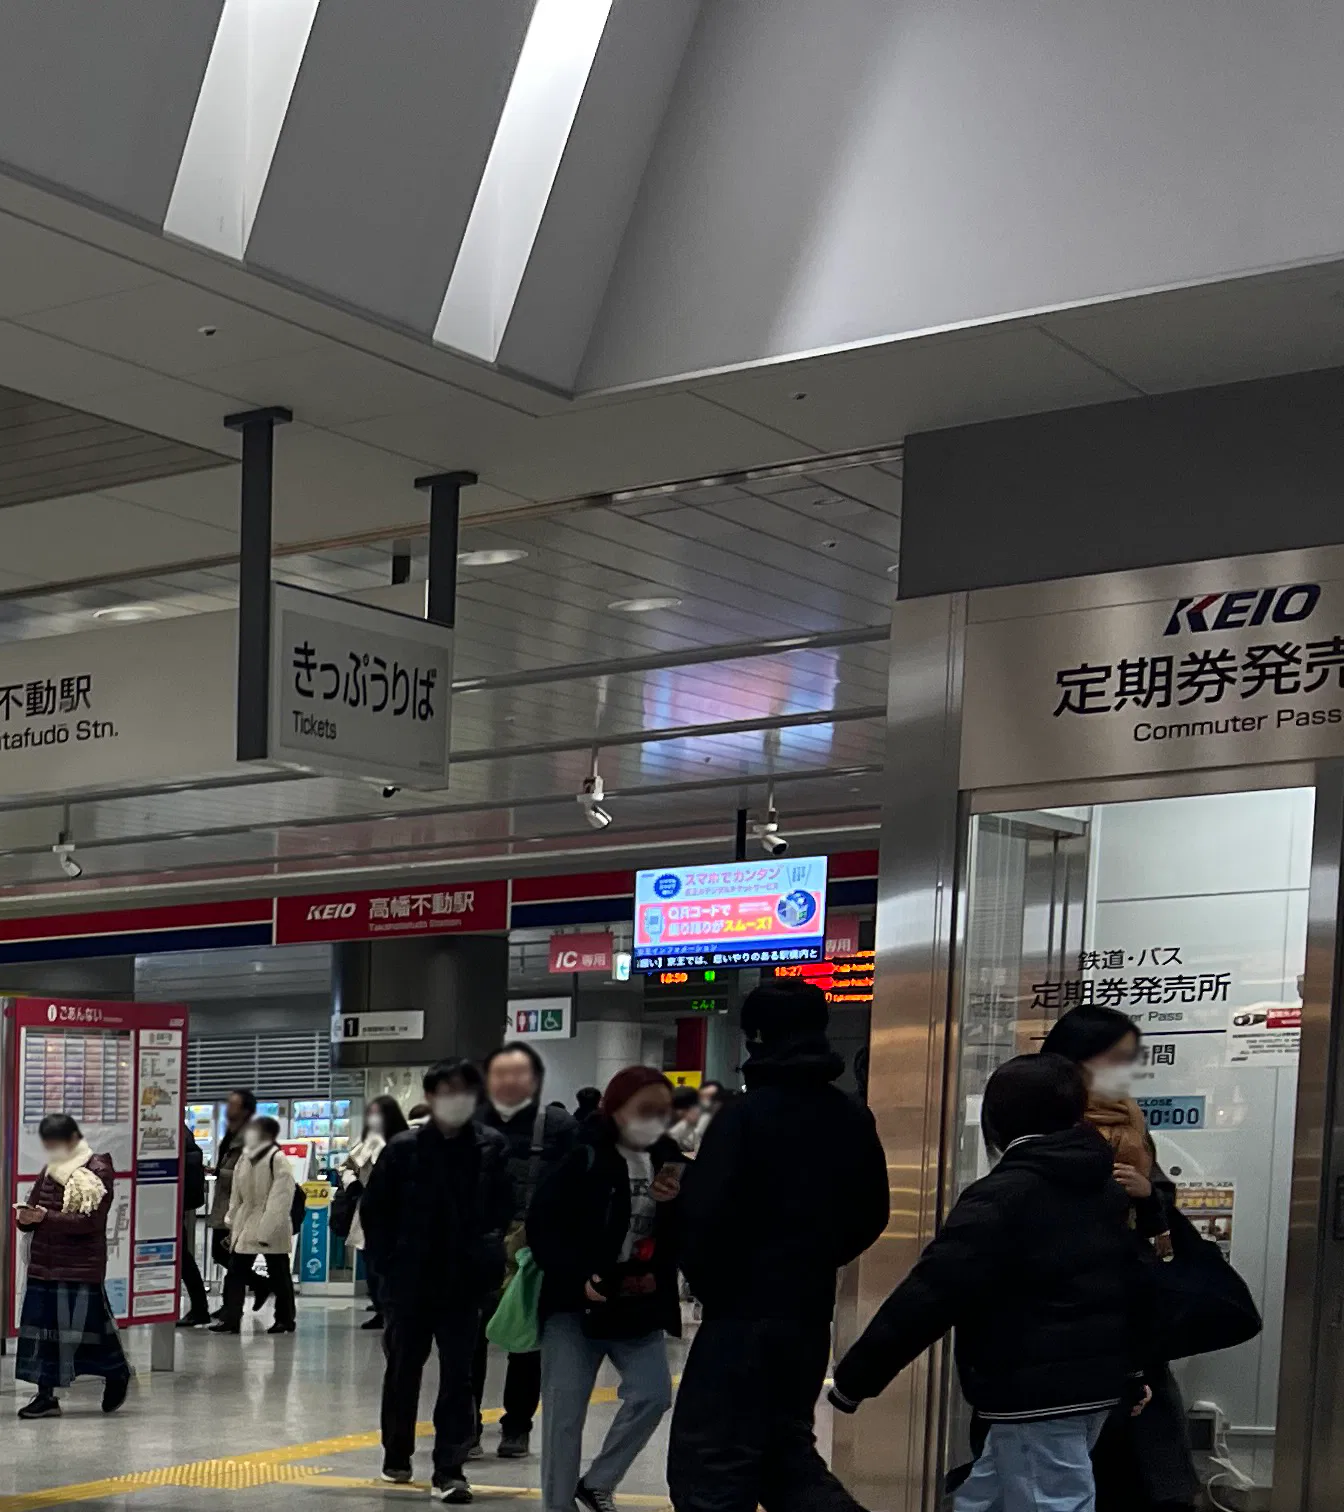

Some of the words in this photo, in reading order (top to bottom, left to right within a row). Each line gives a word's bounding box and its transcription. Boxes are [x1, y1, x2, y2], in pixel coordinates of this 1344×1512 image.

[1163, 583, 1321, 636] KEIO
[293, 640, 437, 721] きっぷうりば
[76, 719, 119, 741] Stn.
[293, 710, 337, 740] Tickets
[1134, 714, 1268, 742] Commuter
[306, 902, 357, 920] KEIO
[369, 890, 474, 919] 高幡不動駅
[556, 951, 578, 968] IC
[1030, 972, 1231, 1009] 定期券発売所
[1148, 1011, 1183, 1021] Pass
